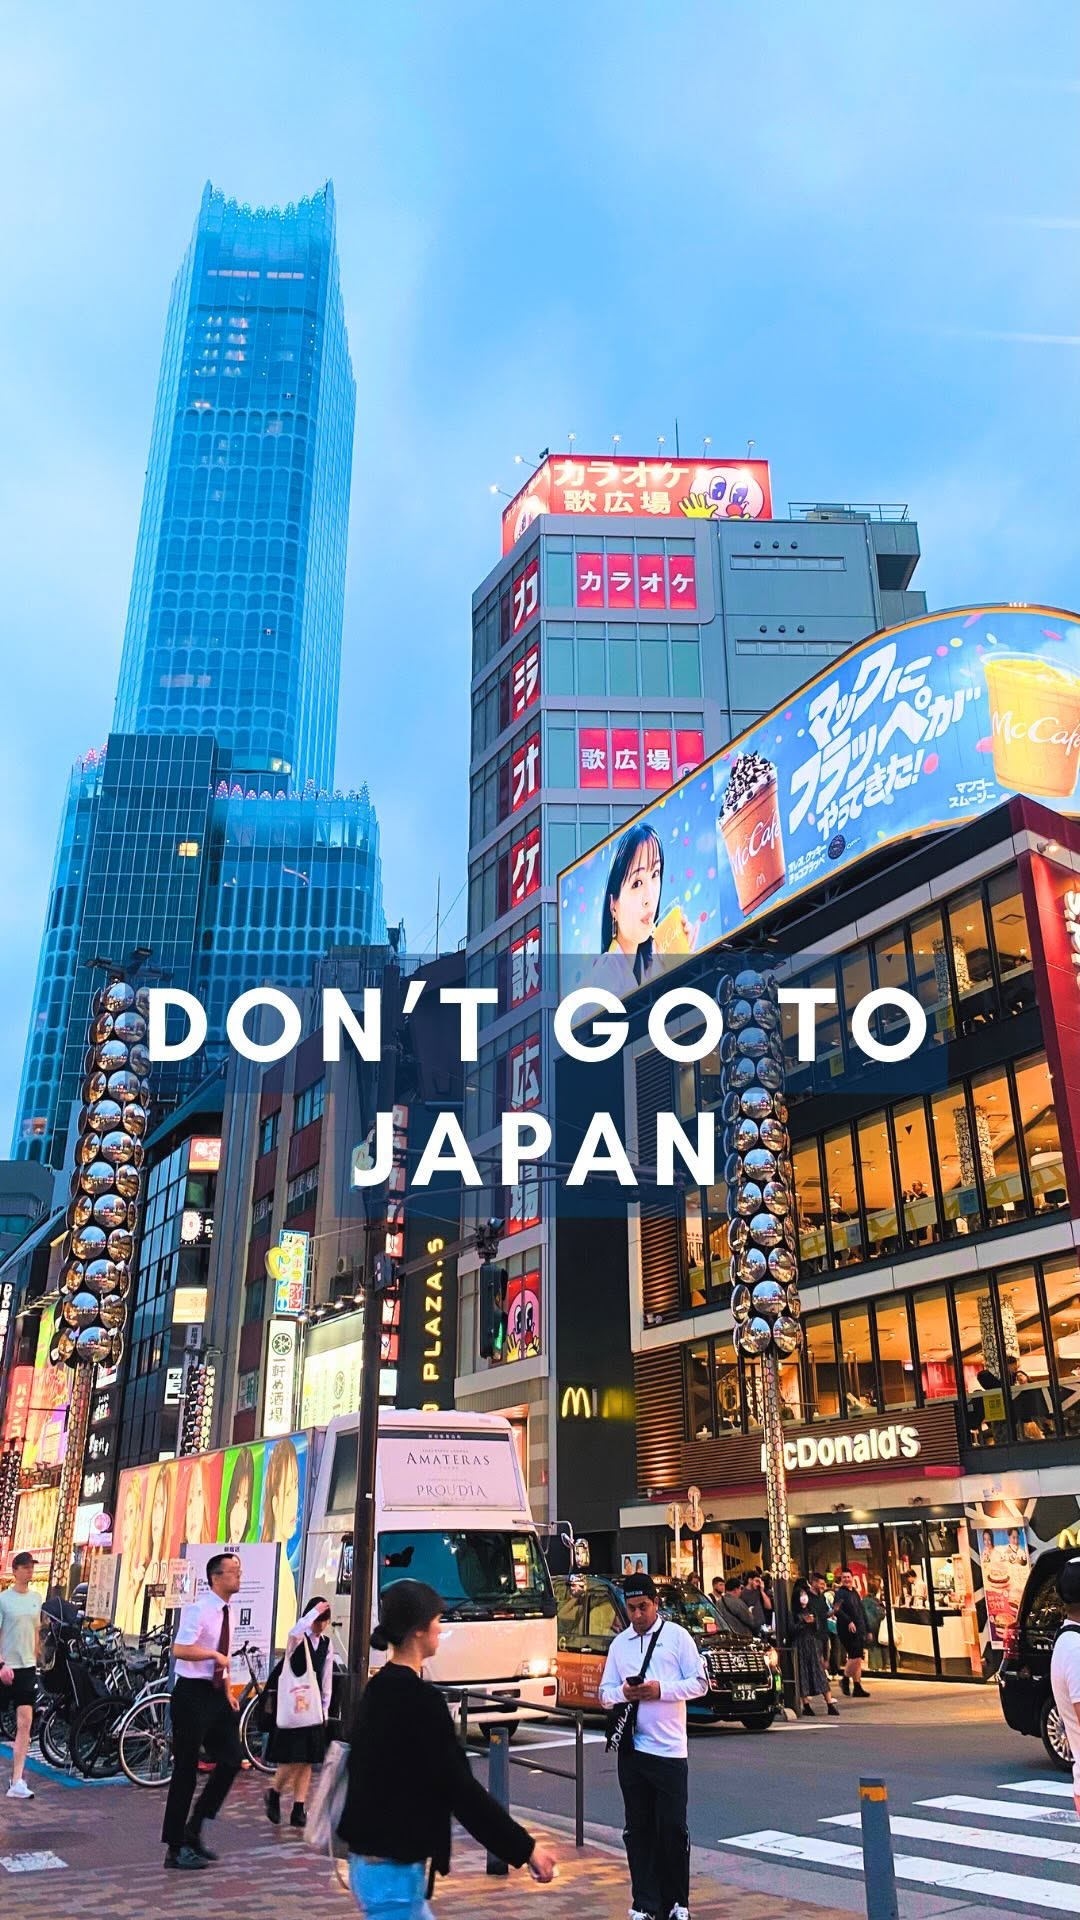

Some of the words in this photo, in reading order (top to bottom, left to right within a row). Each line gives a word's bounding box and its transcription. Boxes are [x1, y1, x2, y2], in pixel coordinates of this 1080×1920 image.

[553, 460, 690, 488] カラオケ
[563, 489, 672, 515] 歌広場
[580, 571, 694, 593] カラオケ
[808, 642, 933, 751] マックに
[581, 747, 671, 771] 歌広場
[789, 686, 981, 835] フラッペが
[948, 790, 996, 809] スムージー
[955, 778, 994, 794] マンゴー
[269, 1358, 287, 1424] 一軒め酒場
[761, 1425, 921, 1473] cDonald's
